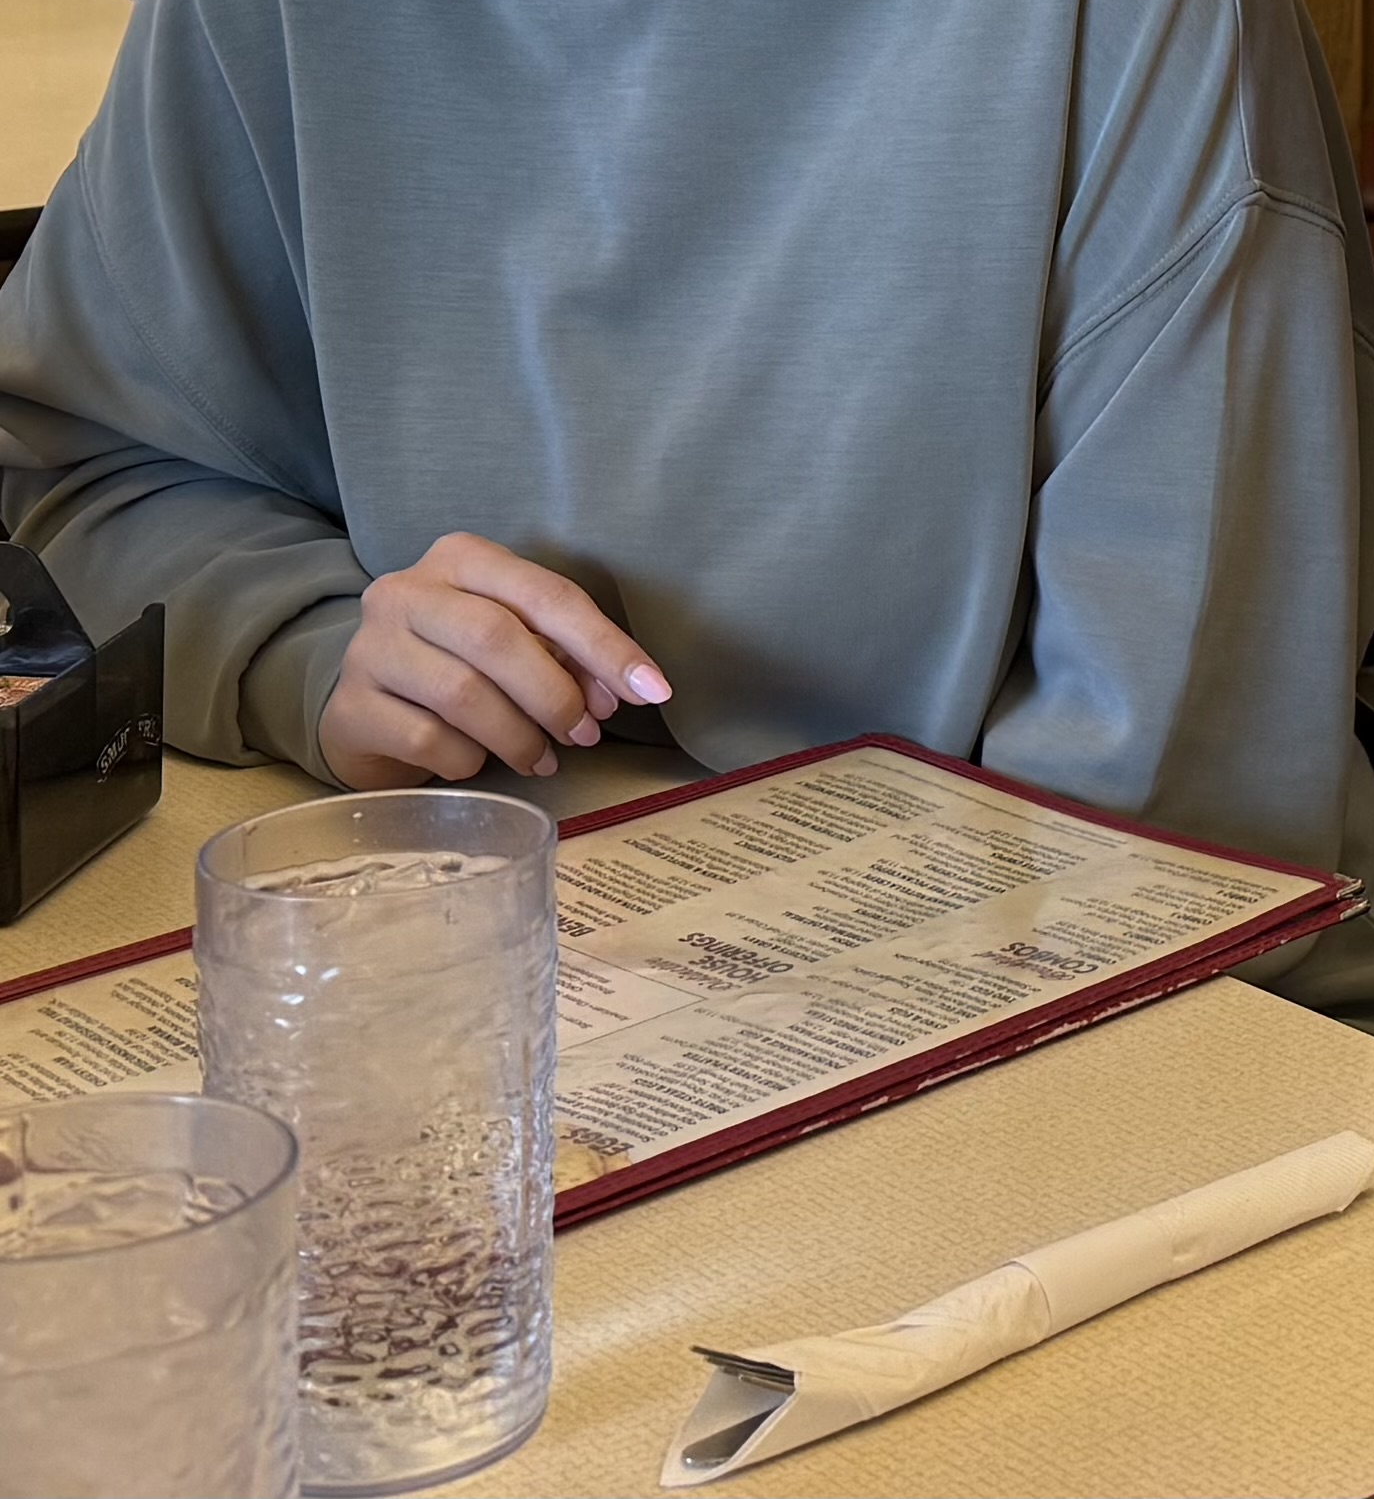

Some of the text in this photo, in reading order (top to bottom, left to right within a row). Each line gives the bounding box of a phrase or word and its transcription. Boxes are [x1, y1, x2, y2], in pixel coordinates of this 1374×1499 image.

[834, 793, 858, 802] HASH
[856, 800, 877, 808] BEEF
[875, 807, 910, 820] CORNED
[771, 811, 854, 841] SOUTHERN BENEDICT
[622, 839, 664, 856] BENEDICT
[734, 841, 796, 863] EGGS BENEDICT
[661, 855, 694, 869] WAFFLE
[991, 853, 1054, 875] TURTLE CREPES
[701, 871, 737, 884] CHICKEN
[862, 874, 891, 885] CREPE
[869, 864, 979, 903] MAPLE TREE PECAN CREPES
[924, 864, 1006, 893] VERY BERRY CREPES
[890, 883, 925, 898] NUTELLA
[1223, 892, 1257, 903] COMBO
[621, 902, 651, 915] BACON
[927, 897, 963, 909] BANANA
[853, 909, 913, 928] FRUIT CREPES
[1177, 914, 1212, 925] COMBO
[782, 911, 872, 942] HOMEMADE OATMEAL
[742, 936, 772, 947] GRAVY
[830, 937, 860, 947] FRESH
[1130, 933, 1164, 944] COMBO
[679, 933, 792, 972] OFFERINGS
[778, 948, 819, 963] BISCUITS
[1001, 943, 1097, 973] COMBOS
[1081, 953, 1116, 964] COMBO
[689, 956, 768, 983] HOUSE
[972, 951, 1074, 980] Breakfast
[645, 958, 740, 990] Distinctive
[969, 986, 1016, 1003] TWO EGGS
[888, 1007, 914, 1017] EGGS
[936, 1003, 976, 1018] ONE EGG
[805, 1010, 905, 1045] COUNTRY FRIED STEAK
[920, 1019, 947, 1029] GYRO
[738, 1030, 763, 1039] EGGS
[787, 1025, 875, 1058] CORNED BEEF HASH
[769, 1040, 810, 1056] SAUSAGE
[109, 1045, 155, 1071] WISCONSIN
[683, 1052, 723, 1067] PLATTER
[809, 1055, 845, 1069] POLISH
[632, 1078, 658, 1088] EGGS
[758, 1079, 787, 1091] MEAT
[664, 1088, 696, 1101] STEAK
[692, 1099, 728, 1113] RIBEYE
[561, 1128, 633, 1156] EGGS
